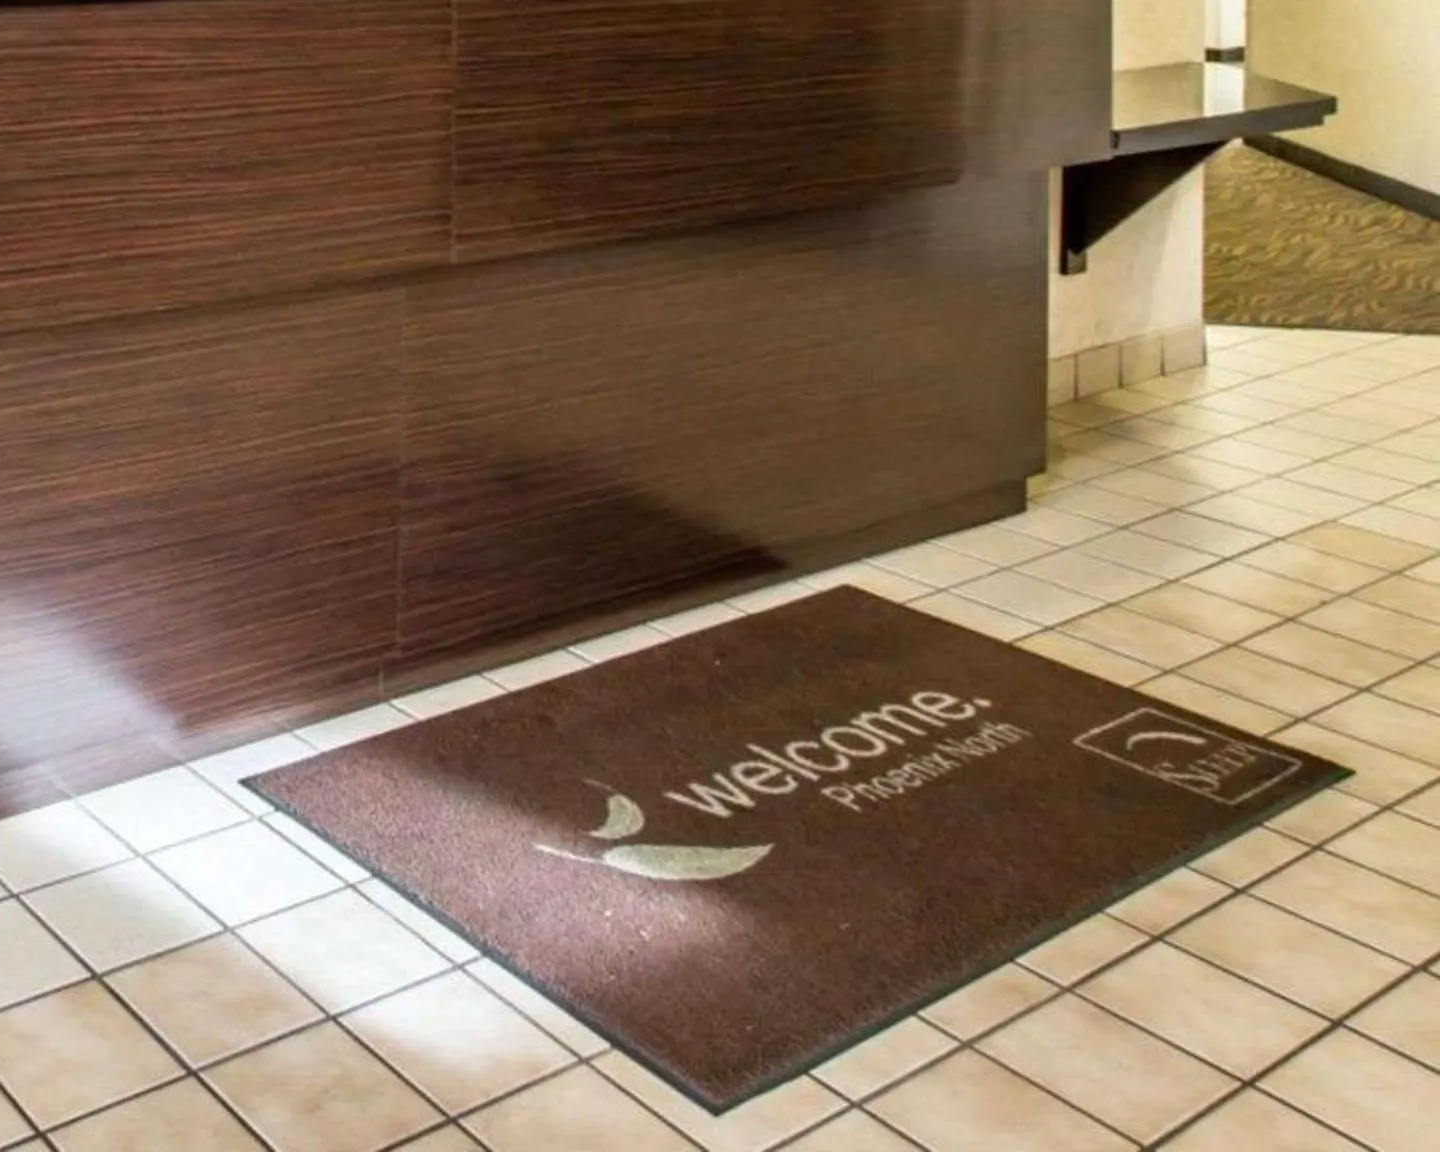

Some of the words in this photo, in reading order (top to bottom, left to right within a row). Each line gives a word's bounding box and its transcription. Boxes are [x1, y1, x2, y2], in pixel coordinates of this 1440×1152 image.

[662, 690, 993, 819] welcome.
[820, 753, 961, 812] Phoenix
[933, 721, 1033, 765] North
